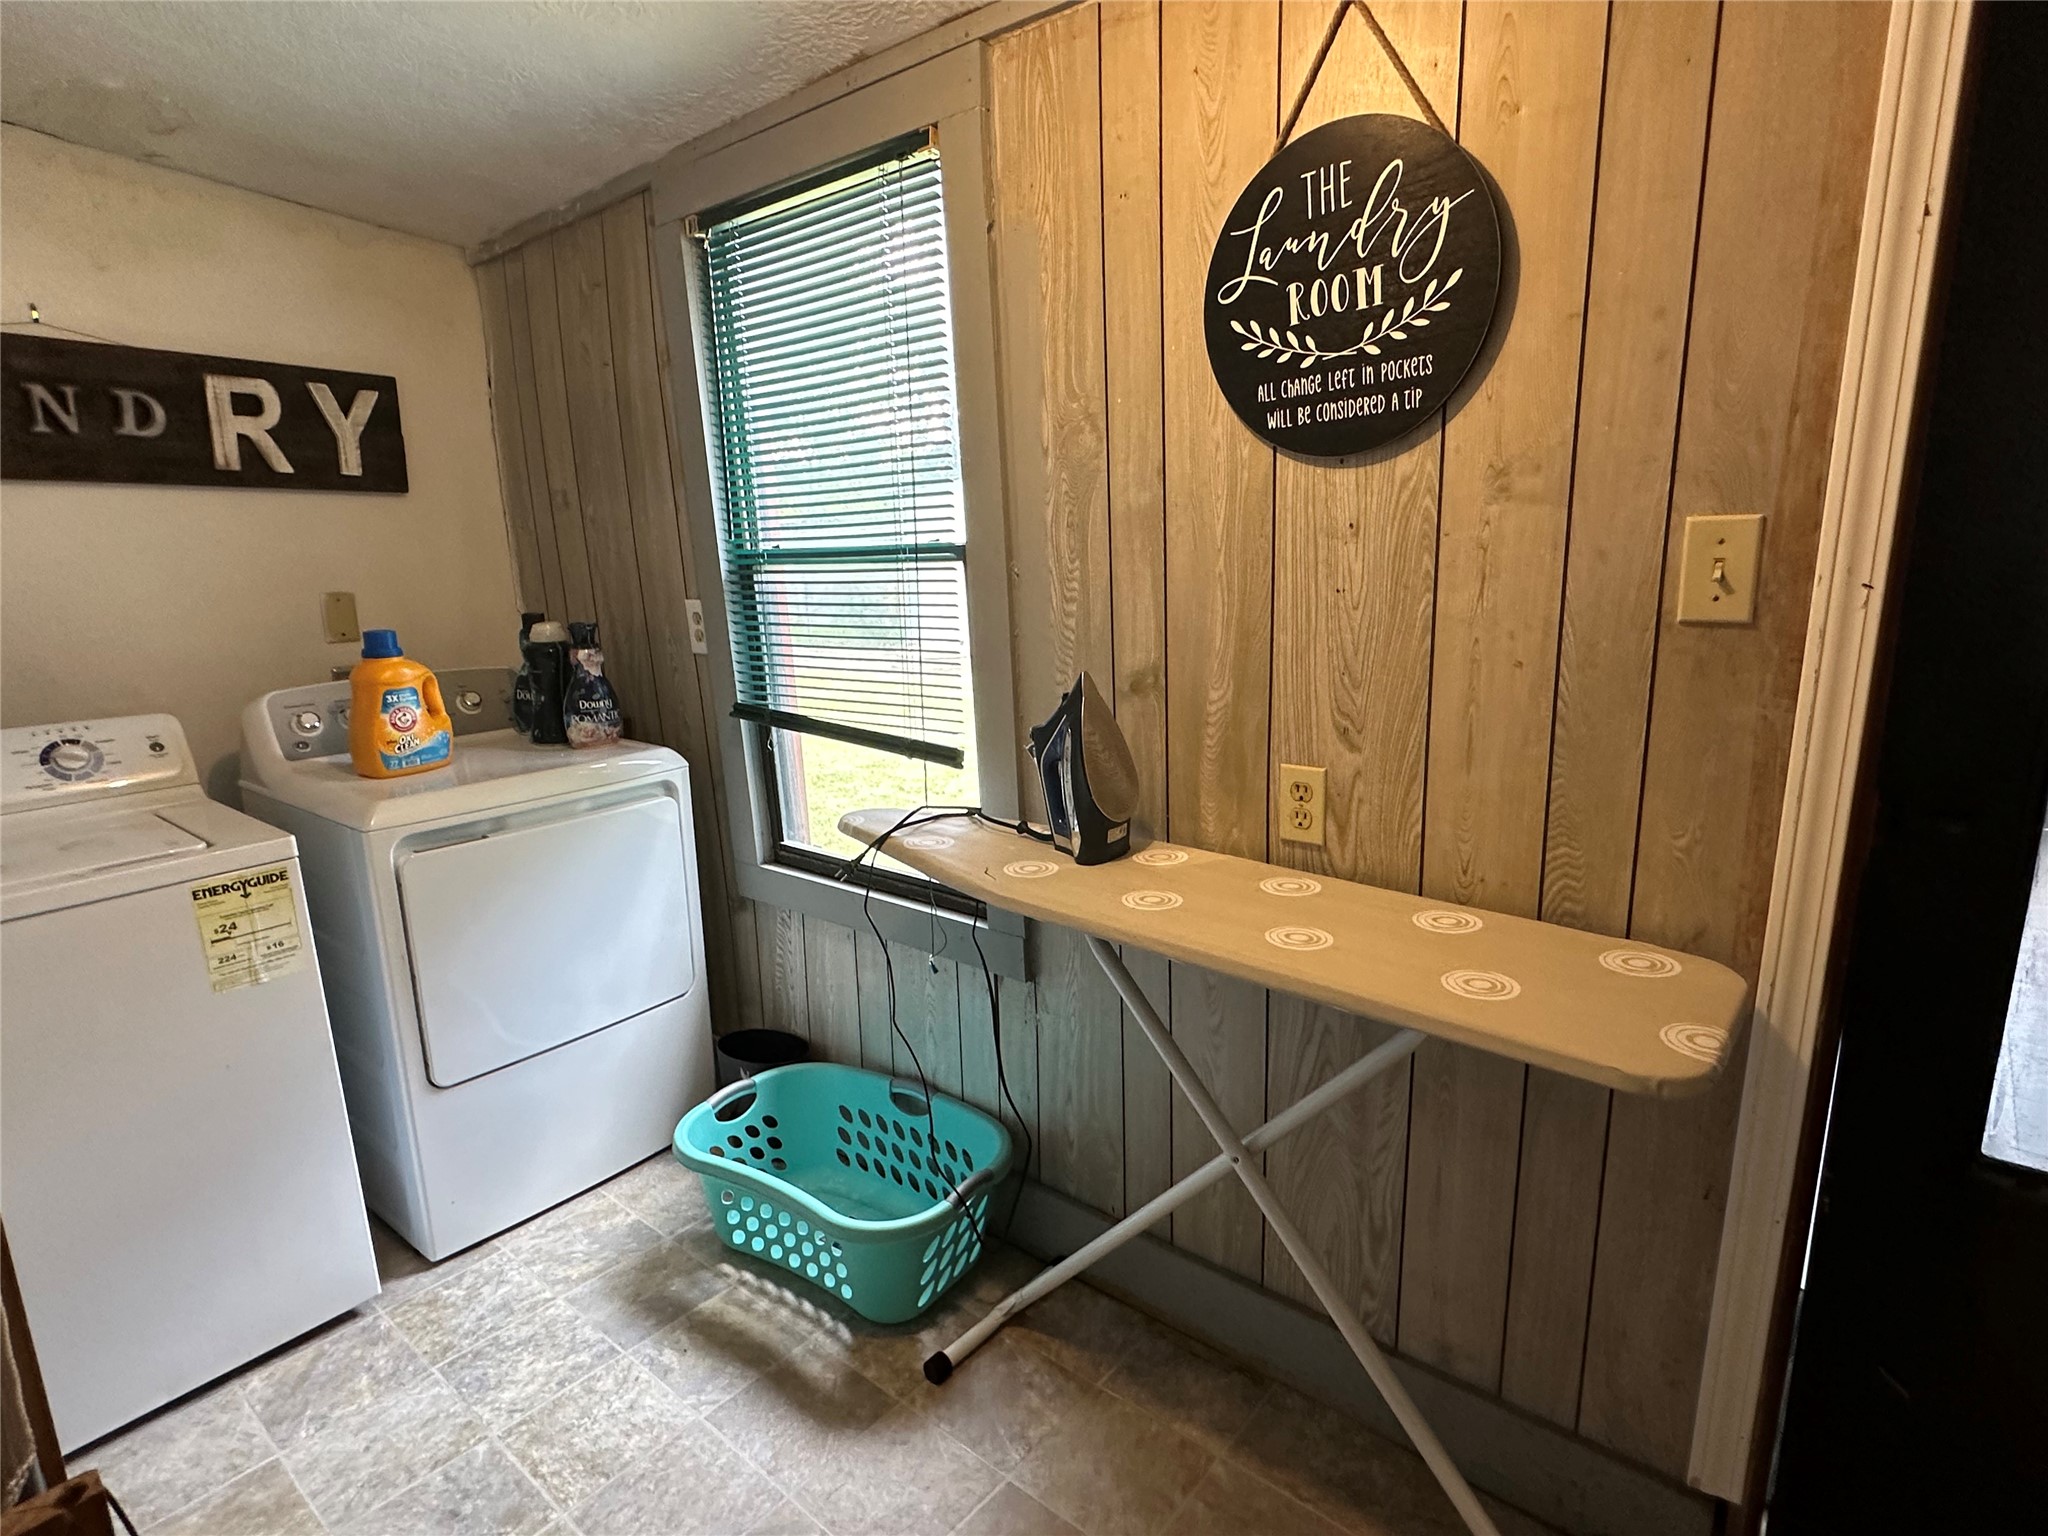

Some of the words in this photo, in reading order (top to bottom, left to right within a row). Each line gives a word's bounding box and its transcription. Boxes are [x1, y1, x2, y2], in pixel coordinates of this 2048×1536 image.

[1300, 160, 1353, 220] THE
[1217, 158, 1475, 305] Laundry
[1286, 264, 1385, 327] ROOM
[1257, 381, 1277, 403] ALL
[1391, 392, 1399, 412] A
[579, 699, 613, 710] Downy
[191, 869, 289, 901] ENERGYGUIDE
